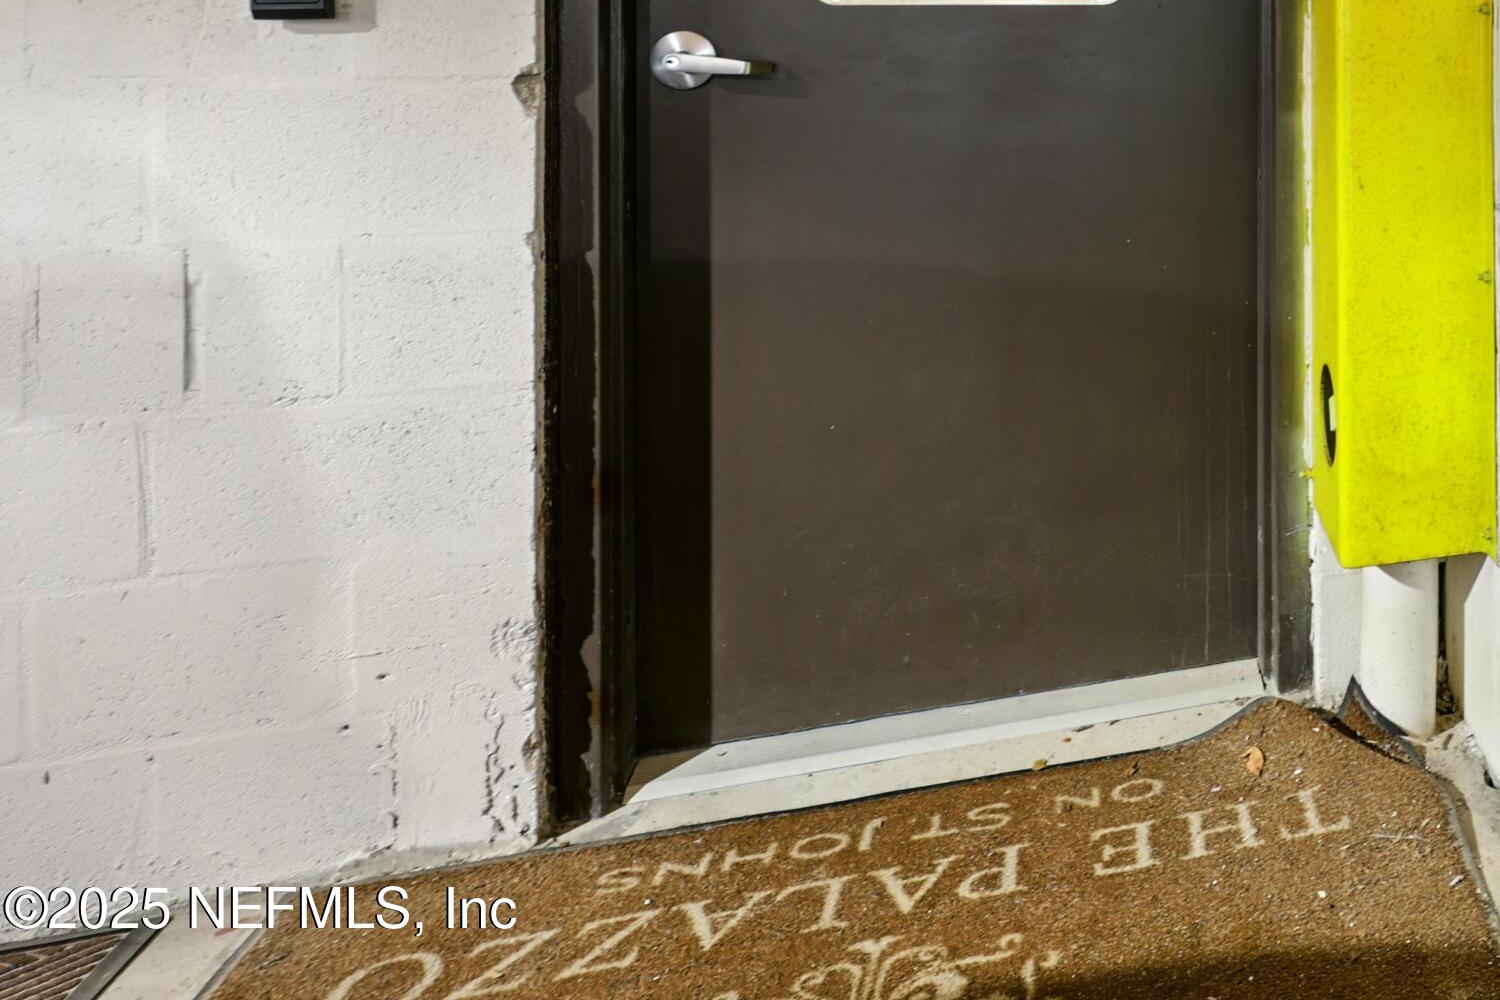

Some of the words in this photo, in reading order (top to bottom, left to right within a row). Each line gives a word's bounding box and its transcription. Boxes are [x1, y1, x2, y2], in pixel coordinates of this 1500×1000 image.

[1055, 778, 1160, 811] ON
[1091, 785, 1351, 877] THE
[599, 818, 883, 891] JOHNS
